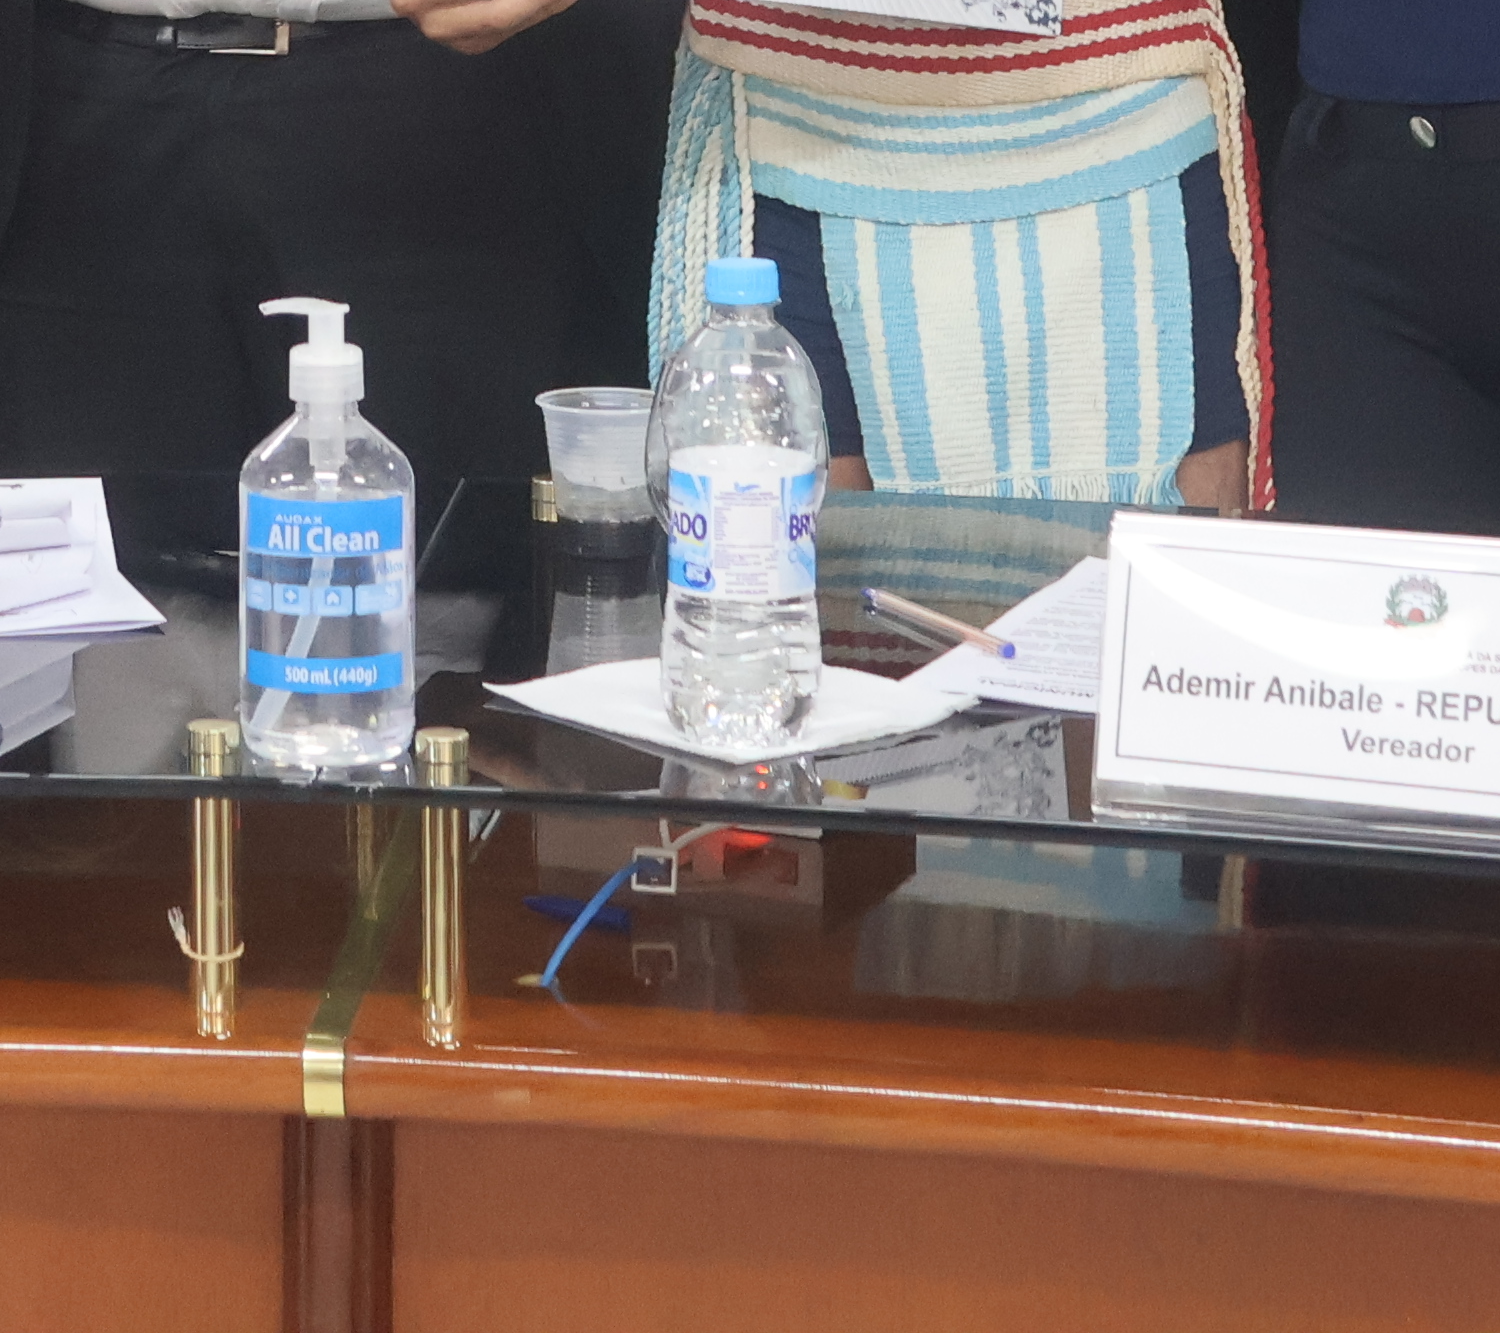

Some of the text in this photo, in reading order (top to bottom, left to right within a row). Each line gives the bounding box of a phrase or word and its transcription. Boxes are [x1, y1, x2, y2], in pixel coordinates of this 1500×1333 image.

[268, 524, 379, 553] All Clean
[284, 667, 308, 683] 500
[333, 665, 377, 686] (440g)
[1142, 664, 1255, 701] Ademir
[1263, 674, 1383, 715] Anibale
[1340, 727, 1477, 764] Vereador
